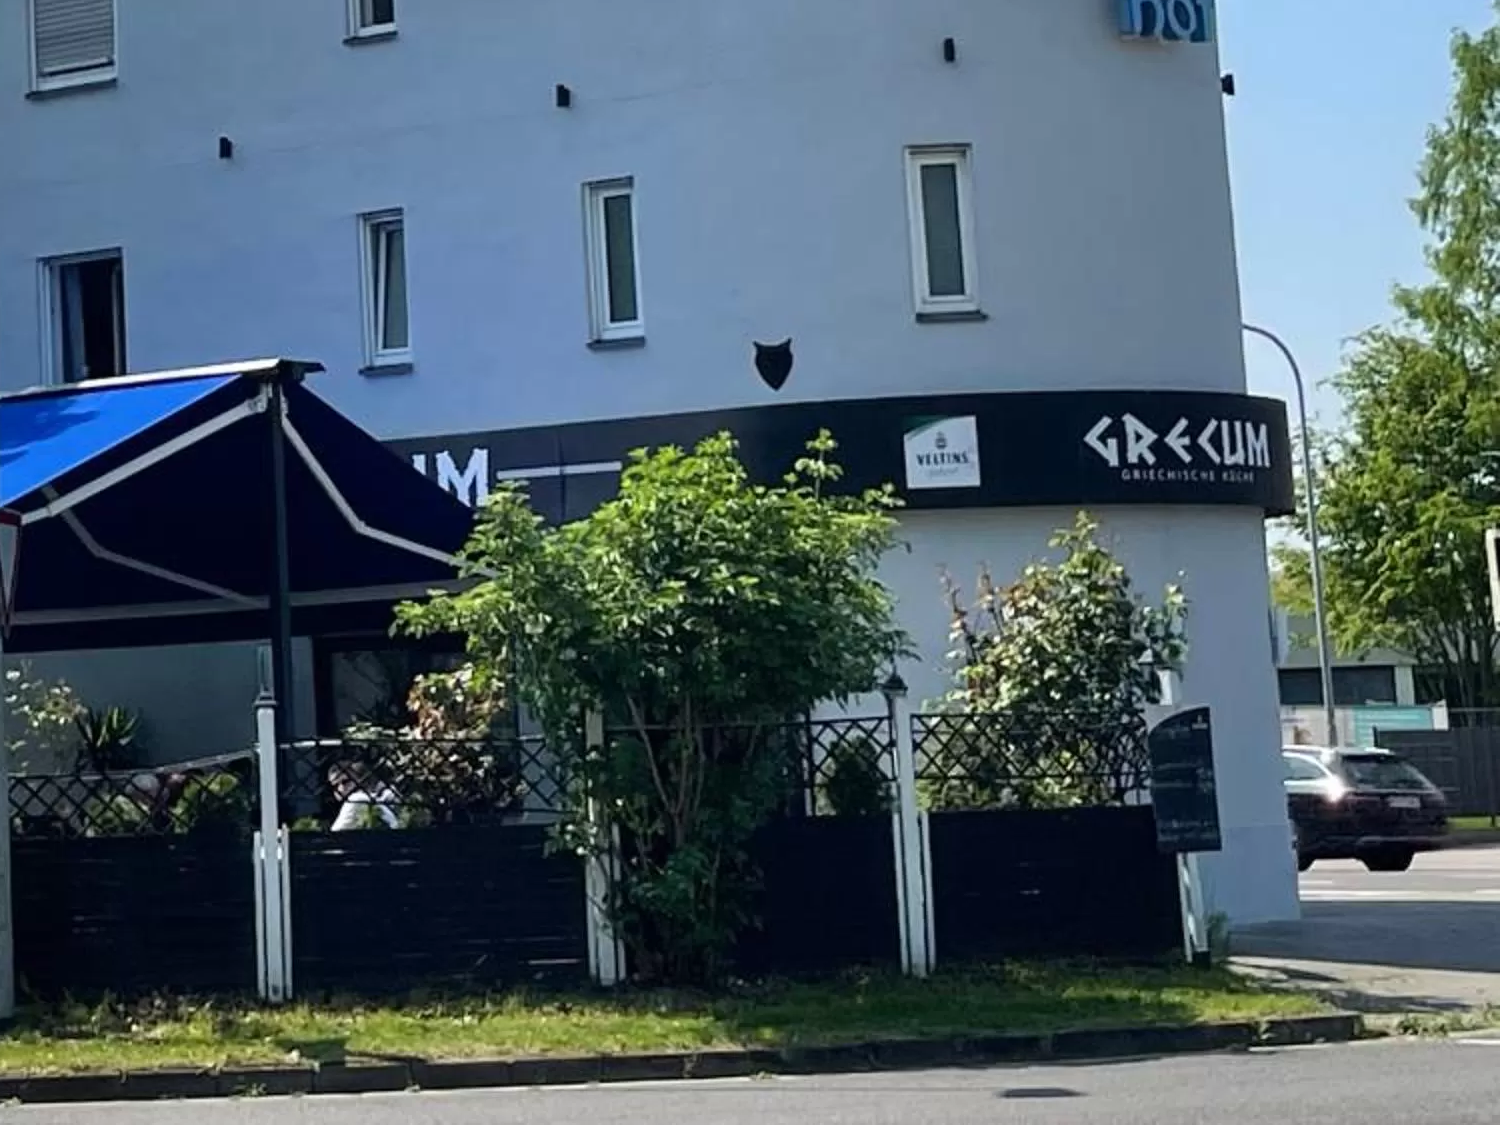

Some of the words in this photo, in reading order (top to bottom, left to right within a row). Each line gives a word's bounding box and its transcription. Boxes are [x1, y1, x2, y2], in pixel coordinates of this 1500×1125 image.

[1083, 412, 1271, 469] GRECUM
[916, 451, 969, 467] VELTINS
[1120, 467, 1216, 483] GRIECHISCHE
